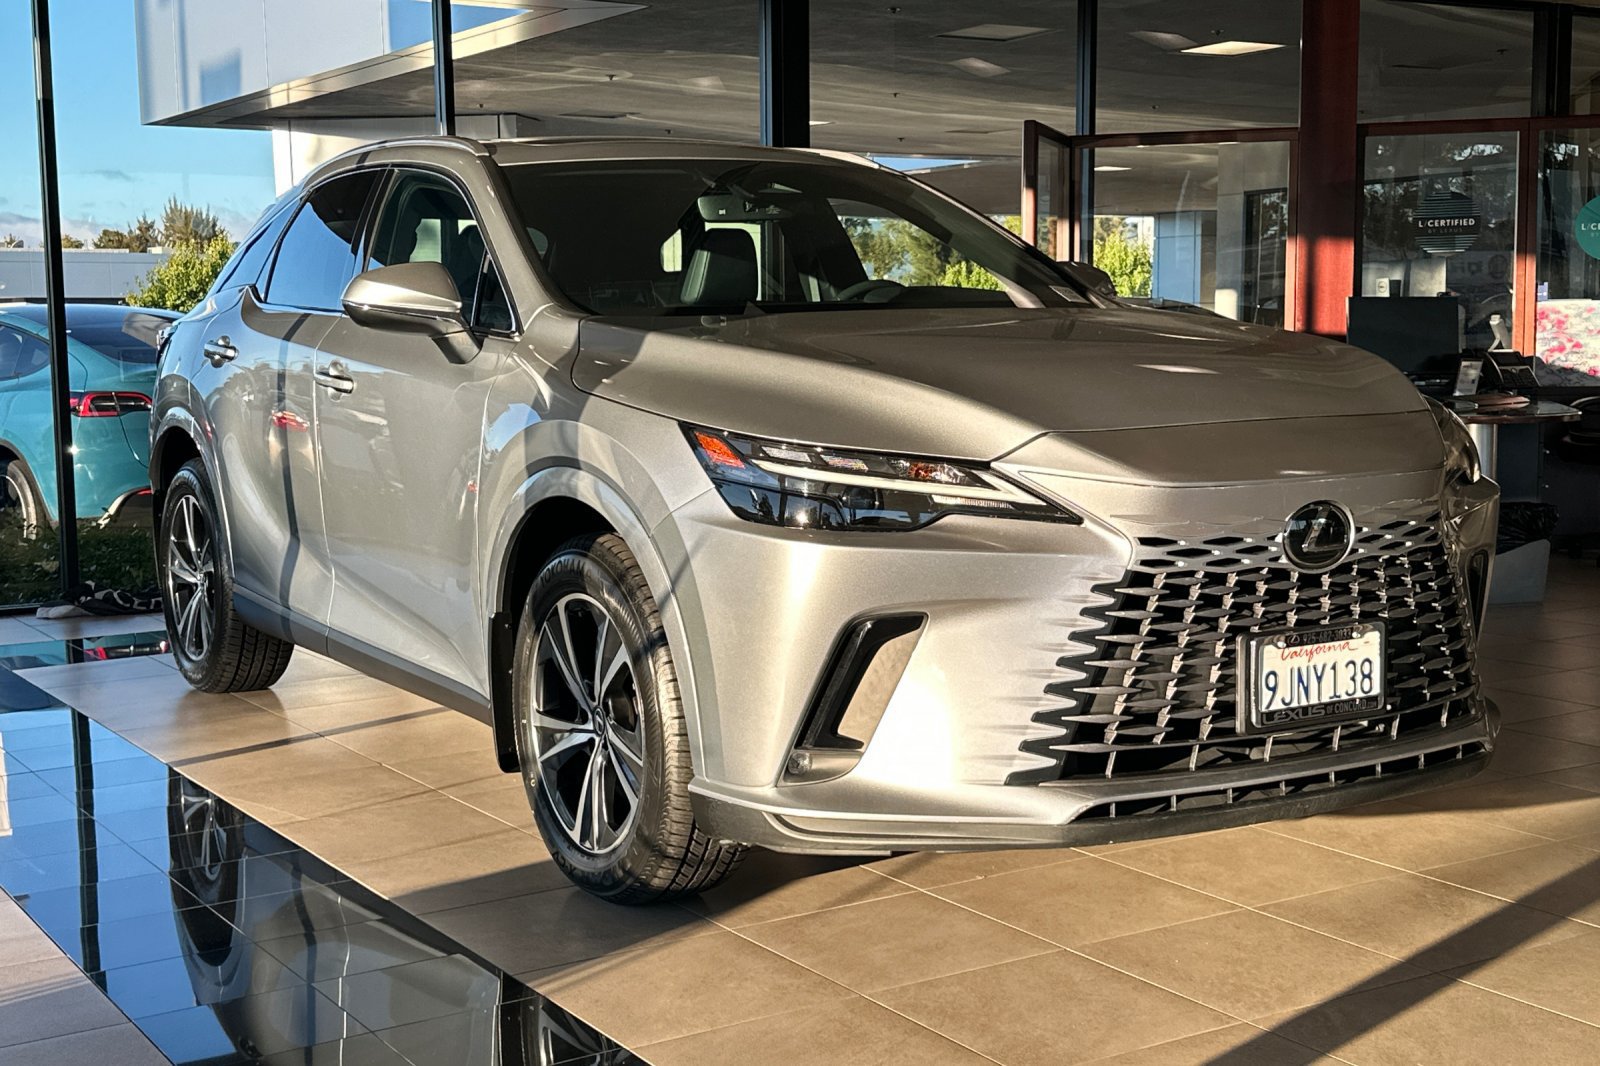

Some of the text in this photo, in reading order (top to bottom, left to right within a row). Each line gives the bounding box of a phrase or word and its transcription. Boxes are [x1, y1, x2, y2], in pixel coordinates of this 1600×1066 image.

[1280, 641, 1359, 663] California
[1264, 657, 1375, 710] 9JNY138
[1262, 704, 1326, 725] LEXUS
